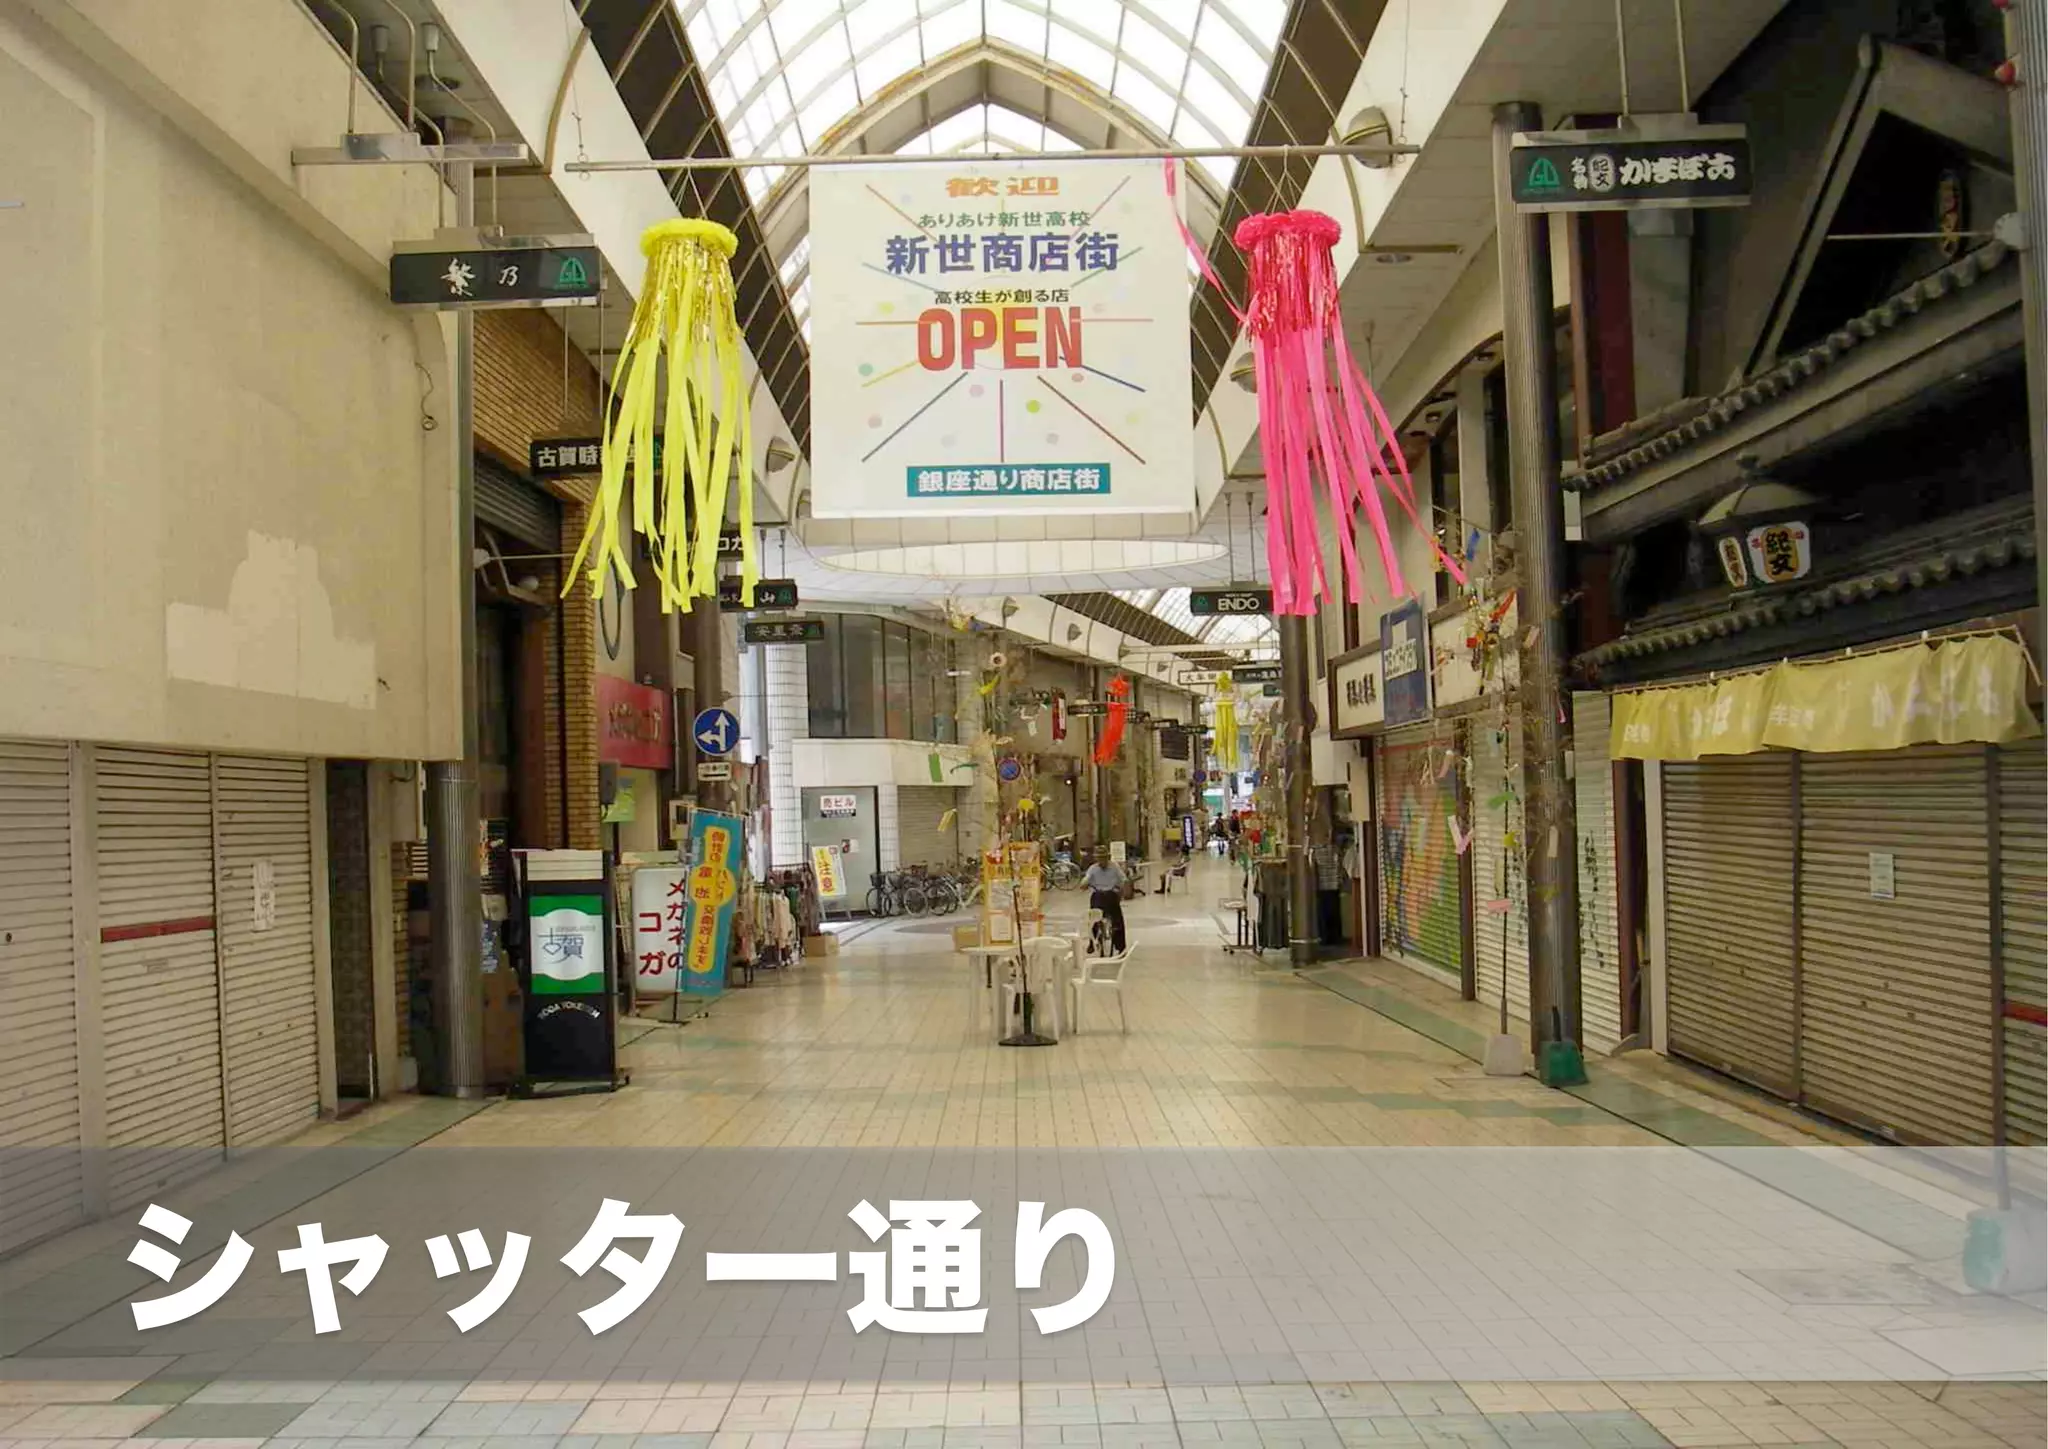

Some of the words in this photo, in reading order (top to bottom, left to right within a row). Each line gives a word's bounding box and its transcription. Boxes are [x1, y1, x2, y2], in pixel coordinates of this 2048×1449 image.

[918, 210, 1092, 229] ありあけ新世高校
[886, 231, 1119, 275] 新世商店街
[934, 288, 1070, 305] 高校生が創る店
[917, 306, 1083, 372] OPEN
[917, 468, 1101, 493] 銀座通り商店街
[1217, 597, 1260, 612] ENDO
[667, 878, 687, 970] メガネの
[638, 911, 667, 977] コガ
